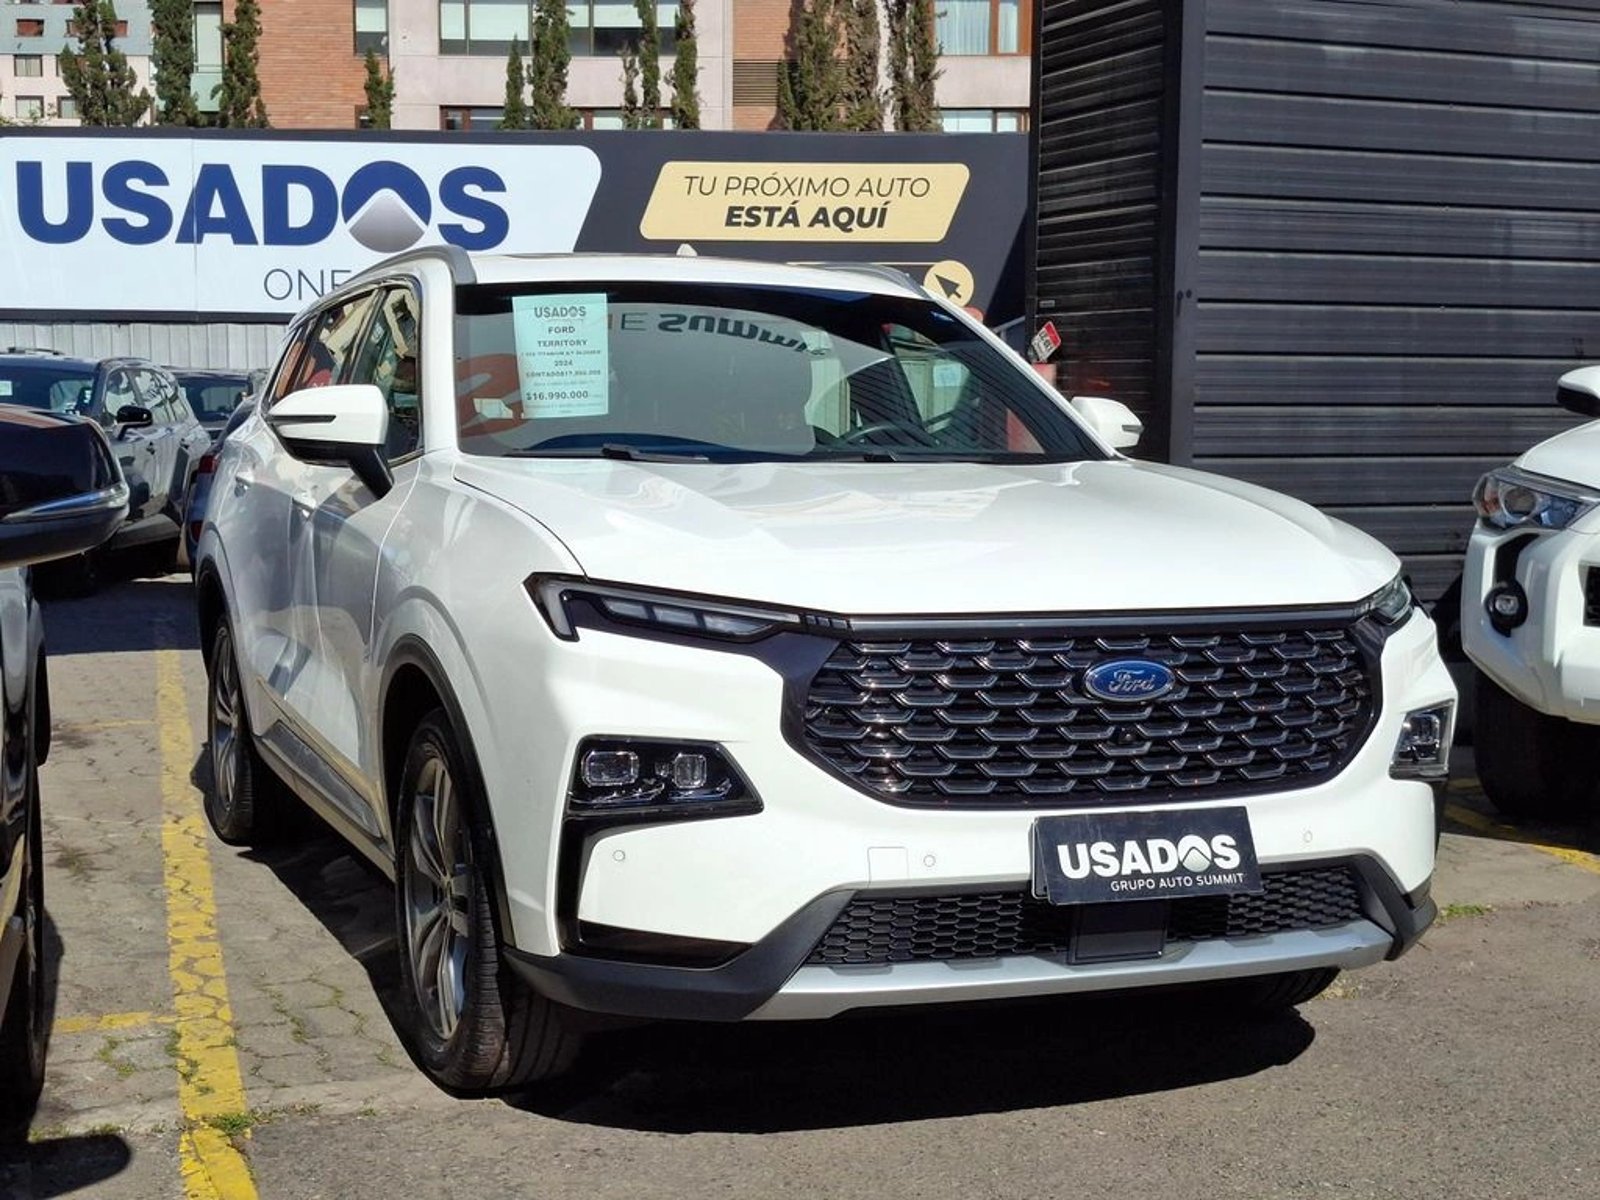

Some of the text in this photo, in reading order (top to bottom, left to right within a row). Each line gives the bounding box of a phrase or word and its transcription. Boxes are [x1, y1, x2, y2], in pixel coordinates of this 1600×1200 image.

[684, 171, 931, 198] TU PRÓXIMO AUTO
[16, 160, 510, 254] USADOS
[724, 200, 891, 232] ESTÁ AQUÍ
[534, 306, 587, 318] USADOS
[548, 326, 576, 334] FORD
[537, 339, 588, 348] TERRITORY
[526, 390, 589, 401] $16.990.000
[1108, 669, 1156, 693] Ford
[1057, 834, 1241, 879] USADOS
[1110, 872, 1245, 893] GRUPO AUTO SUMMIT
